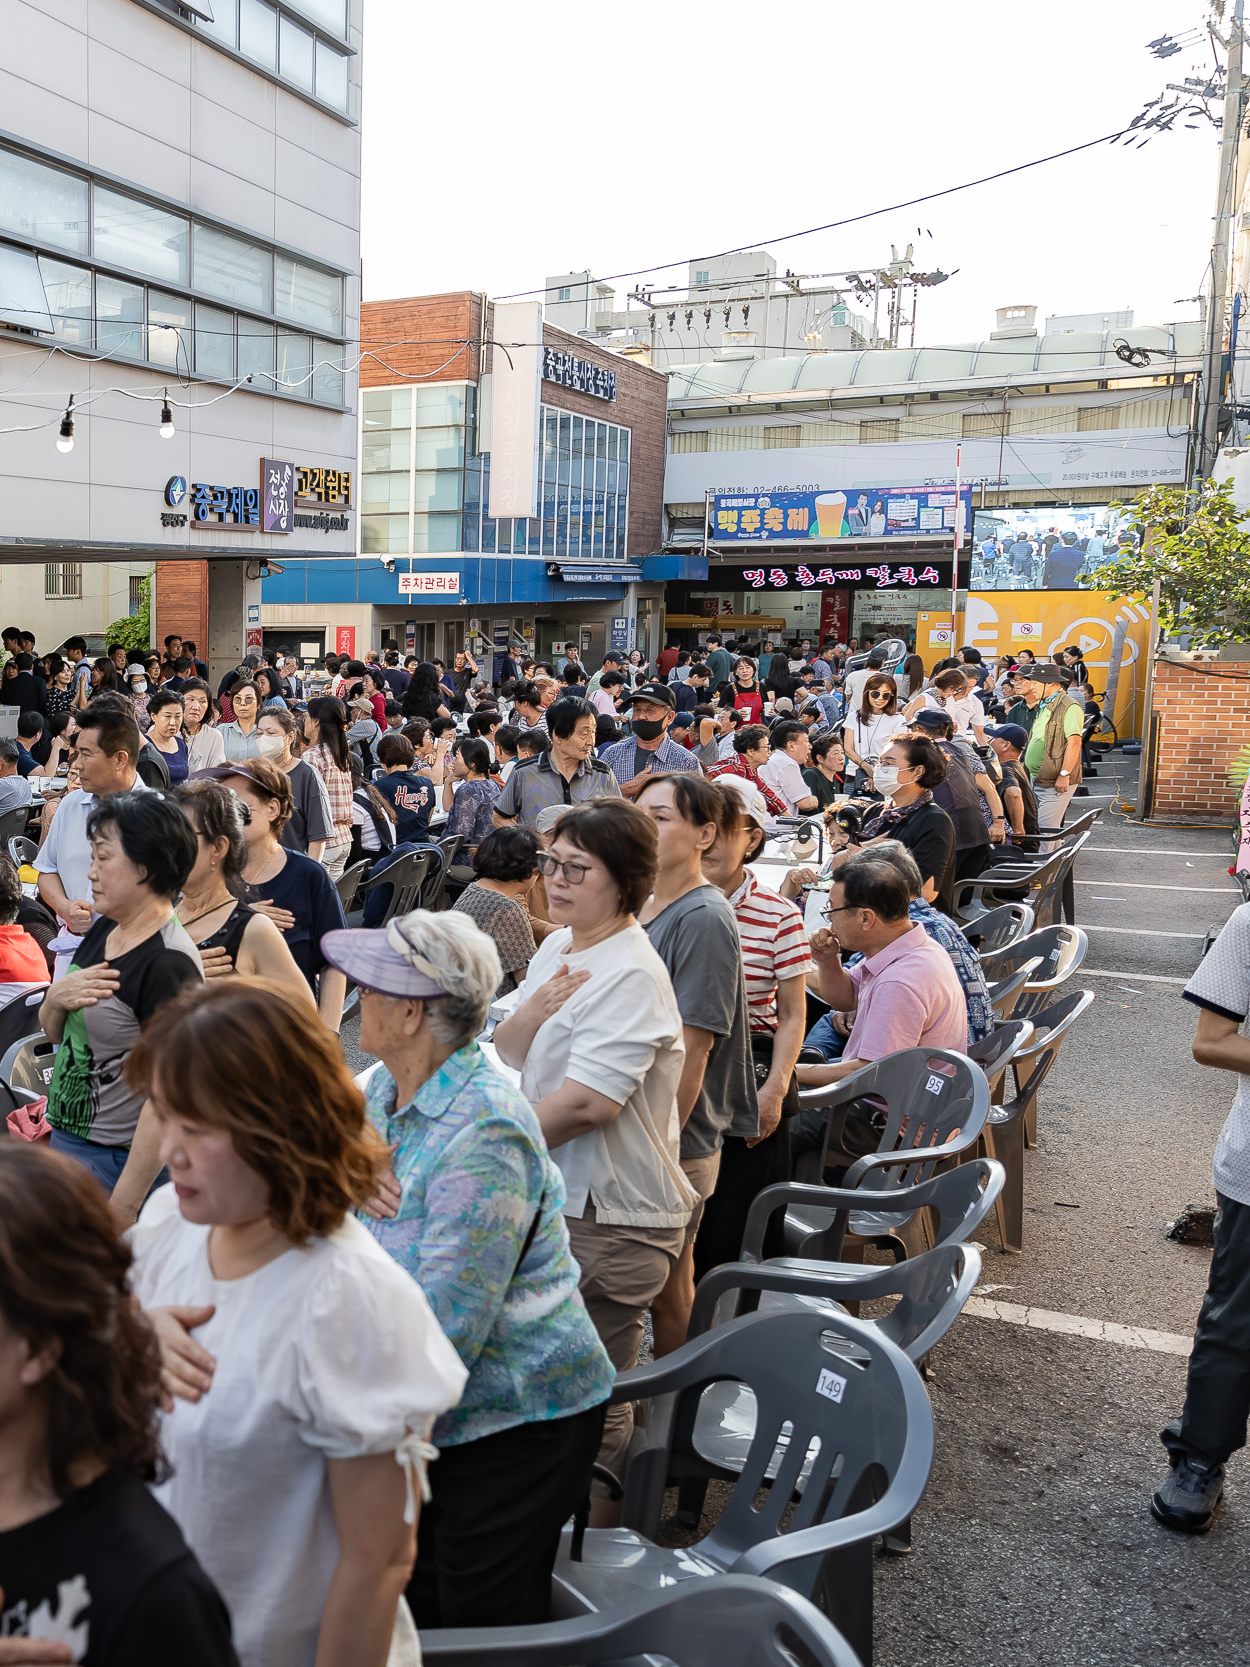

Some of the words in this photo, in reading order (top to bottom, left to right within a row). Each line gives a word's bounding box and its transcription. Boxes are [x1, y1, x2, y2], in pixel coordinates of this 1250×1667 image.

[296, 467, 352, 505] 고객쉼터
[192, 483, 260, 525] 중곡제일
[401, 577, 458, 590] 주차관리실
[743, 567, 788, 588] 명동
[795, 565, 862, 587] 홍두깨
[866, 565, 941, 587] 칼국수
[340, 630, 350, 654] 주차
[928, 1078, 942, 1092] 95
[820, 1375, 841, 1398] 149
